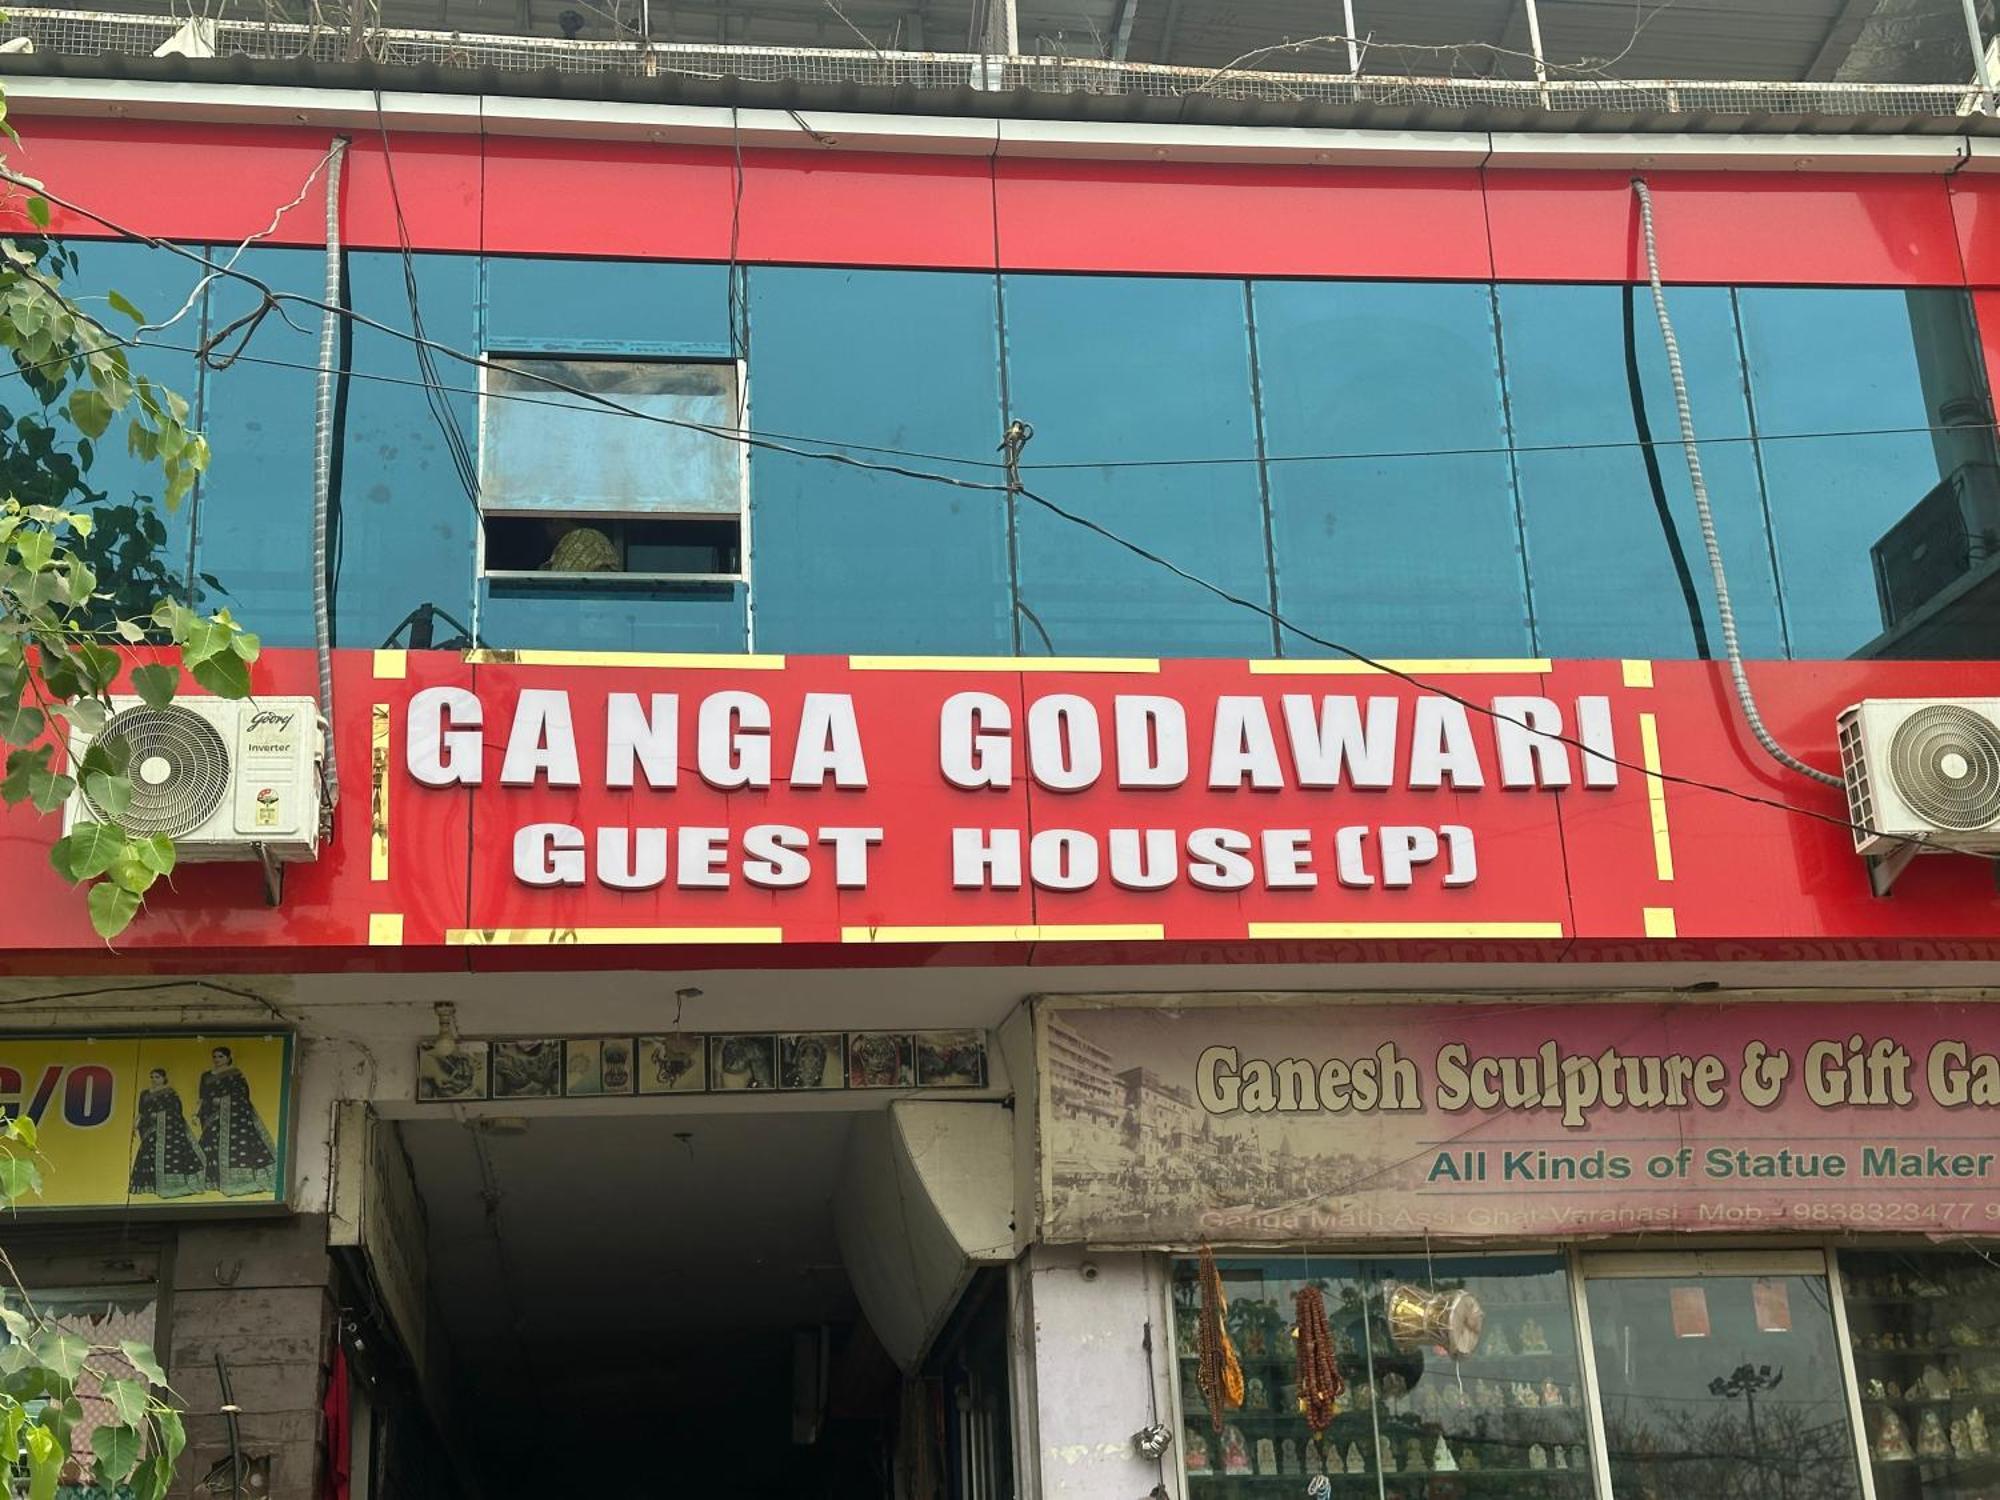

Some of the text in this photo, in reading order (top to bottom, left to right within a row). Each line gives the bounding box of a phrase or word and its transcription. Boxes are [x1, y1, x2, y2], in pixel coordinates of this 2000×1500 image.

[246, 711, 295, 732] Godrej
[406, 686, 1619, 792] GANGA GODAWARI
[248, 743, 291, 752] Inverter
[512, 823, 884, 890] GUEST
[1196, 1033, 2000, 1128] Ganesh Sculpture & Gift Ga
[1427, 1146, 1994, 1184] All Kinds of Statue Maker
[1393, 1208, 1455, 1228] Assi
[1793, 1203, 1974, 1222] 9838323477
